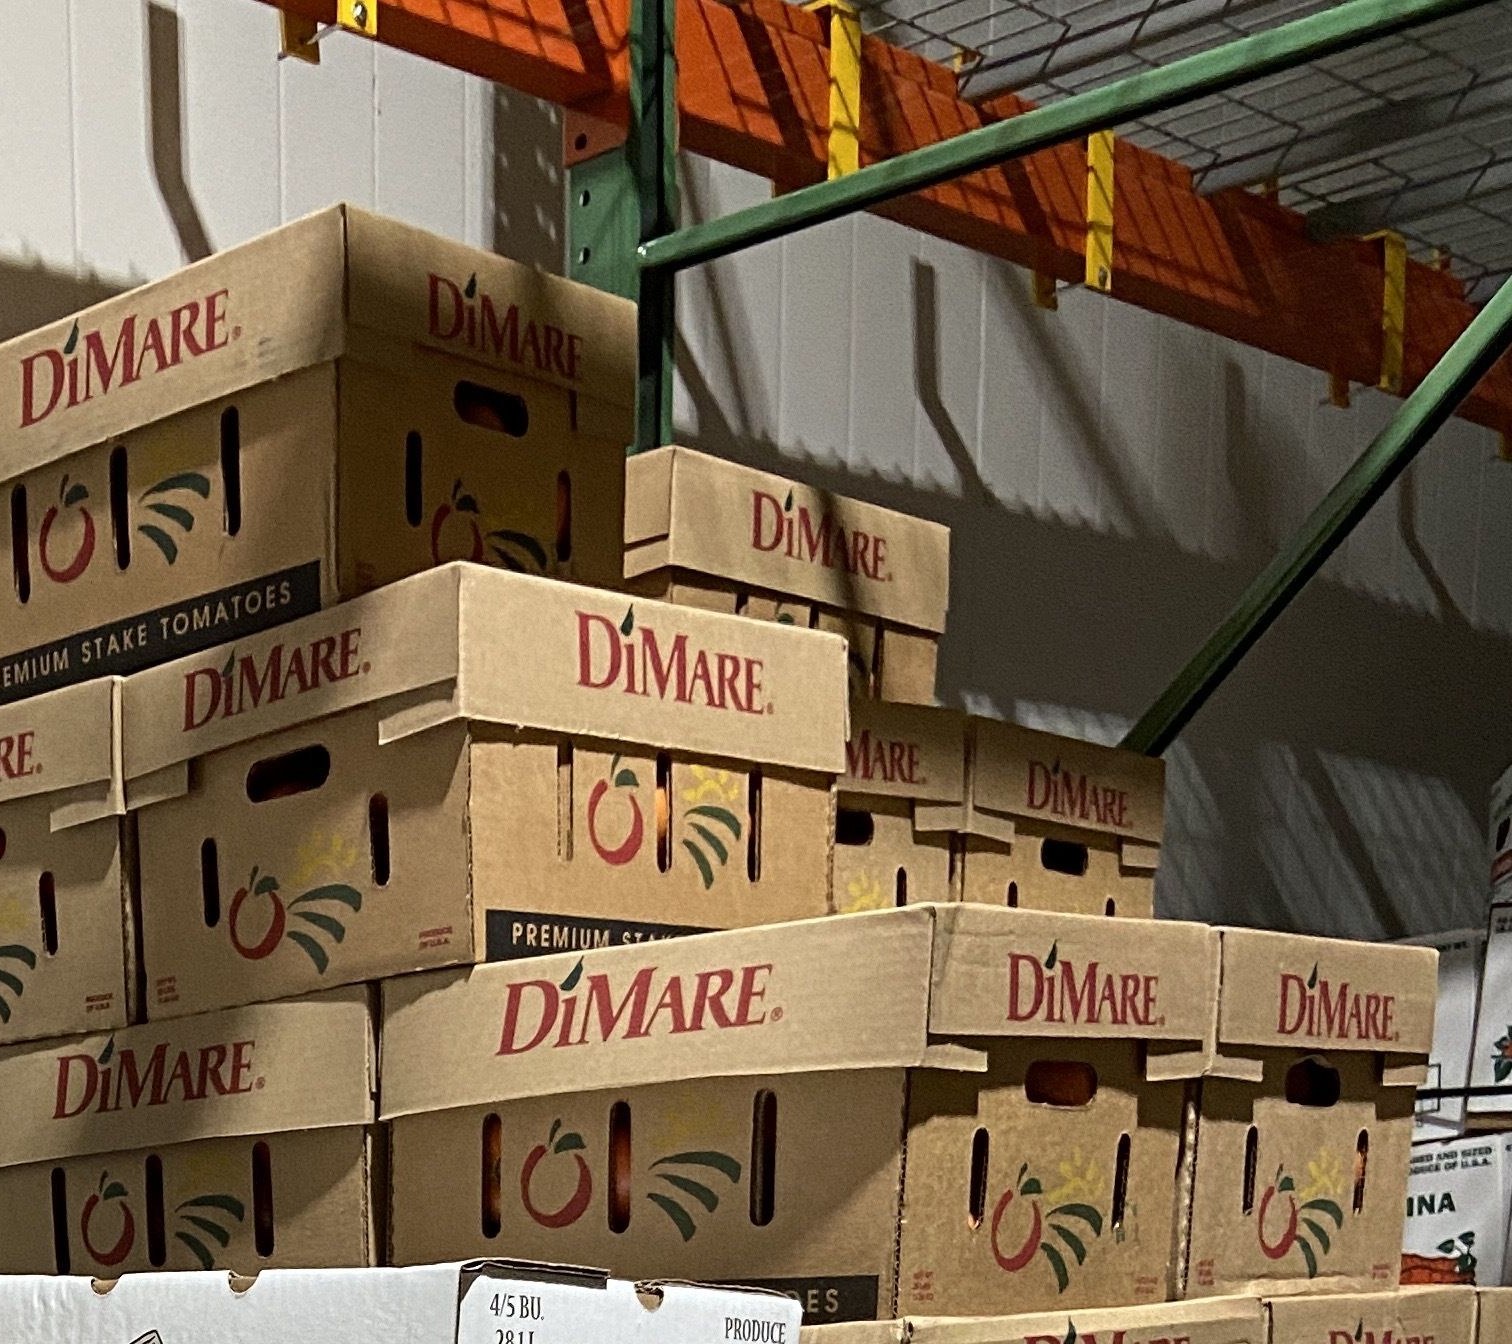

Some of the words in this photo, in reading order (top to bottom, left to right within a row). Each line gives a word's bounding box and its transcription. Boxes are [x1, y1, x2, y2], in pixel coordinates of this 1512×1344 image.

[19, 290, 229, 428] DiMARE
[751, 488, 888, 582] DiMARE
[80, 624, 147, 664] STAKE
[160, 581, 292, 638] TOMATOES
[575, 603, 765, 715] DiMARE
[181, 627, 362, 732] DiMARE
[512, 923, 609, 948] PREMIUM
[495, 956, 773, 1056] DiMARE
[1006, 940, 1159, 1026] DiMARE
[1278, 962, 1396, 1040] DiMARE
[52, 1036, 256, 1119] DiMARE
[725, 1317, 787, 1344] PRODUCE
